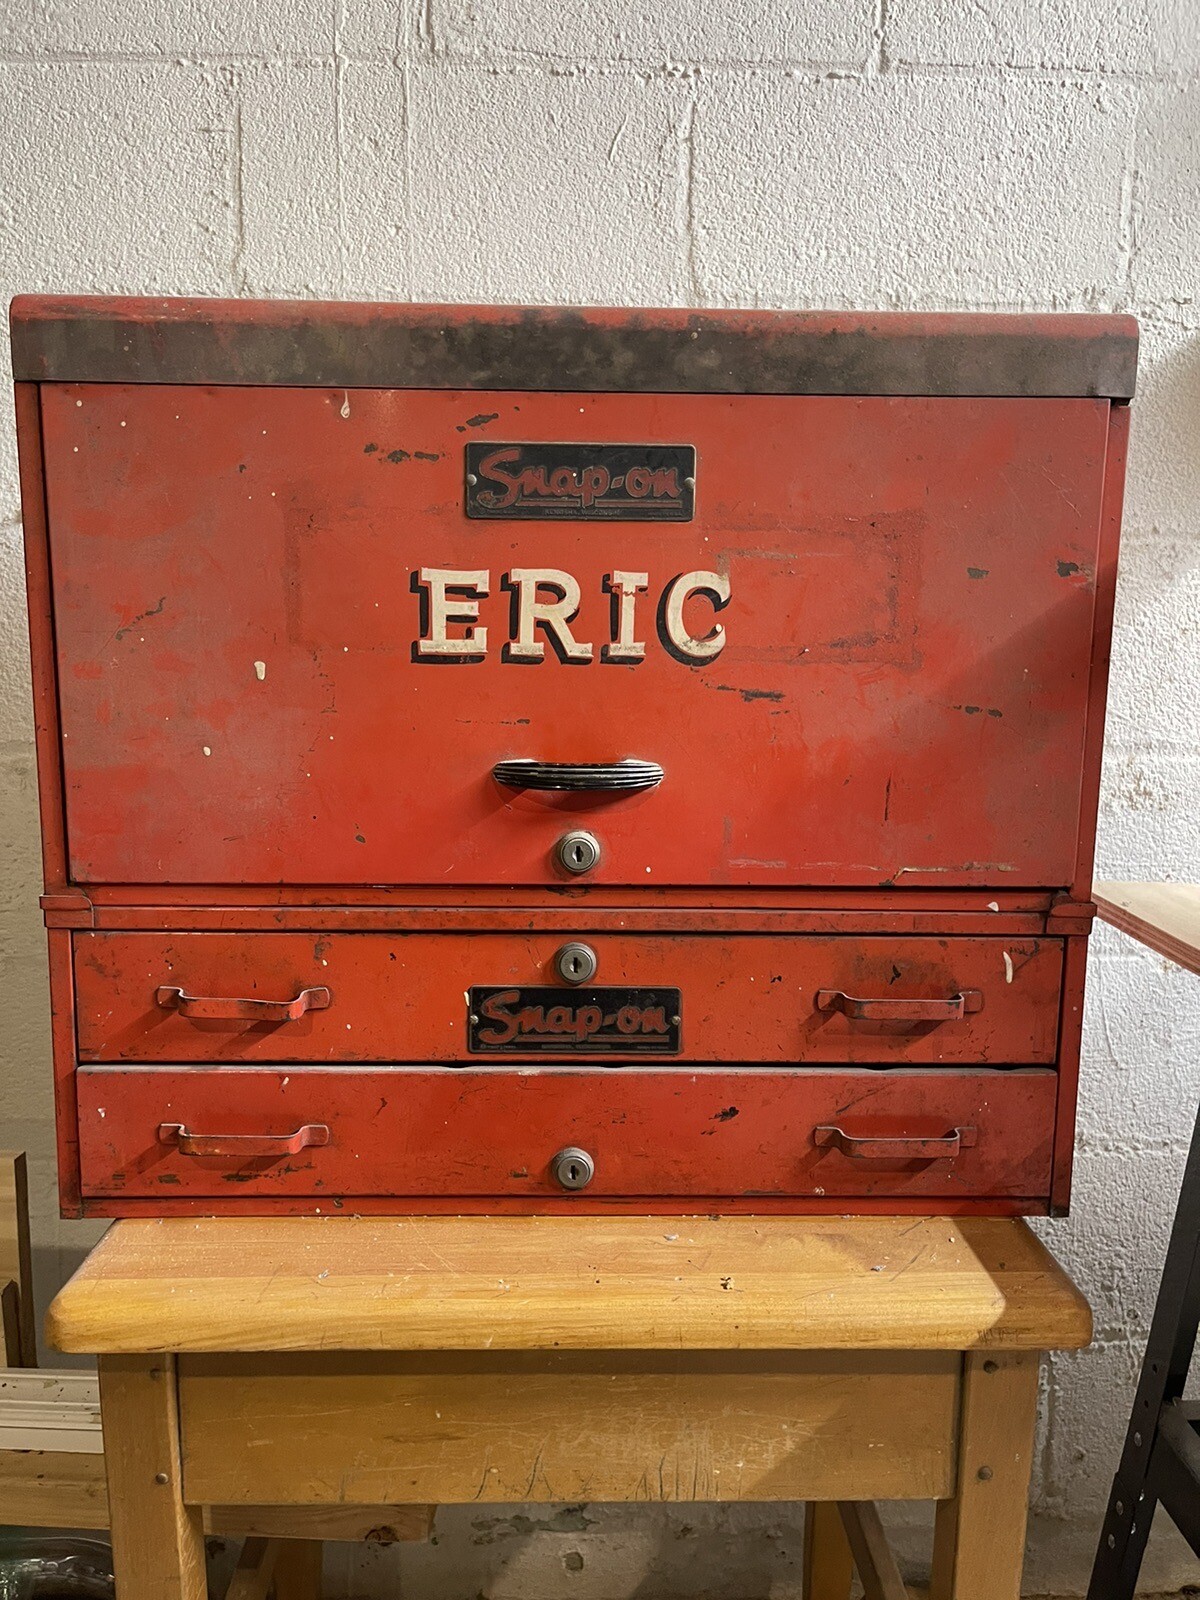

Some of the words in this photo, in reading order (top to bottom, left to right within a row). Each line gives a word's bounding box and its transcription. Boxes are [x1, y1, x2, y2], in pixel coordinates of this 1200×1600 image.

[476, 447, 683, 508] Snap-on
[410, 567, 732, 667] ERIC
[479, 989, 671, 1044] Snap-on
